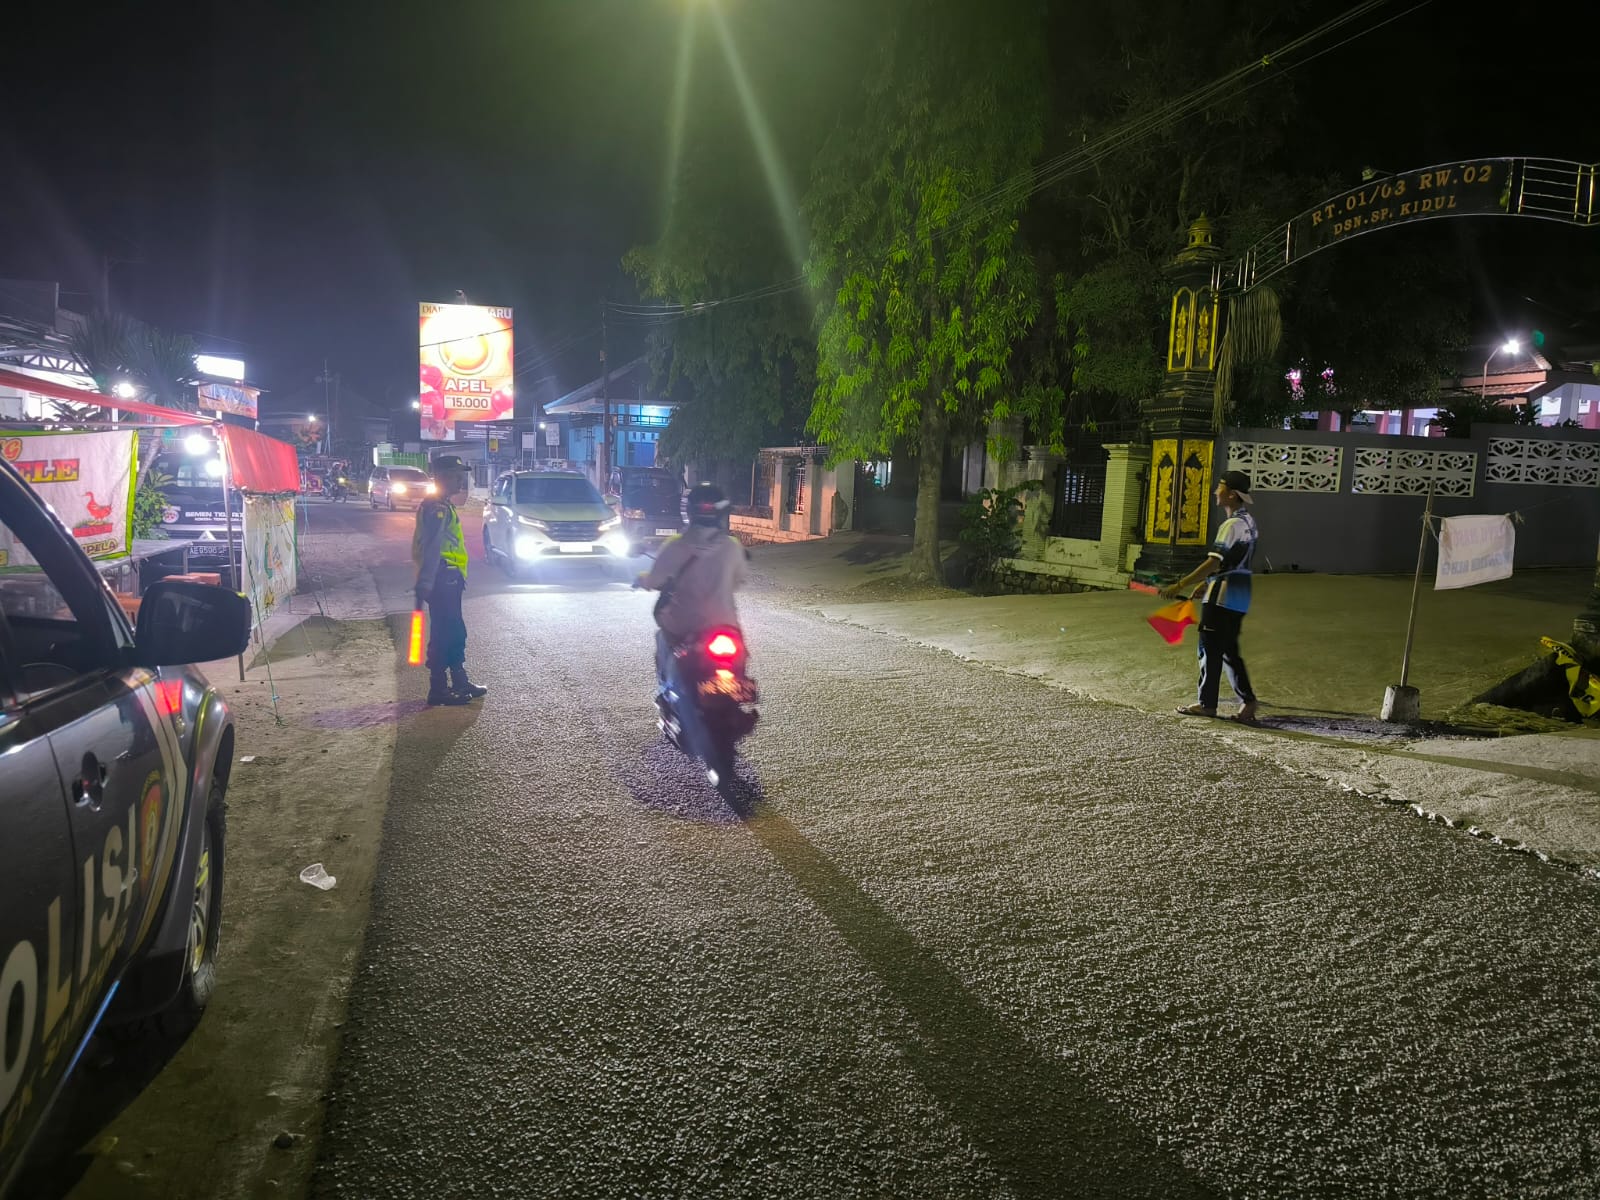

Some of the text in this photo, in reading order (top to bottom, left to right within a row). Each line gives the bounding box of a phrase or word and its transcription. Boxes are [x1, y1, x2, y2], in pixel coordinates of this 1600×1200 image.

[1311, 165, 1493, 226] RT.01/03 RW.02
[1399, 195, 1457, 217] KIDUL
[444, 377, 492, 393] APEL
[451, 396, 489, 409] 15.000
[0, 803, 137, 1118] OLISI
